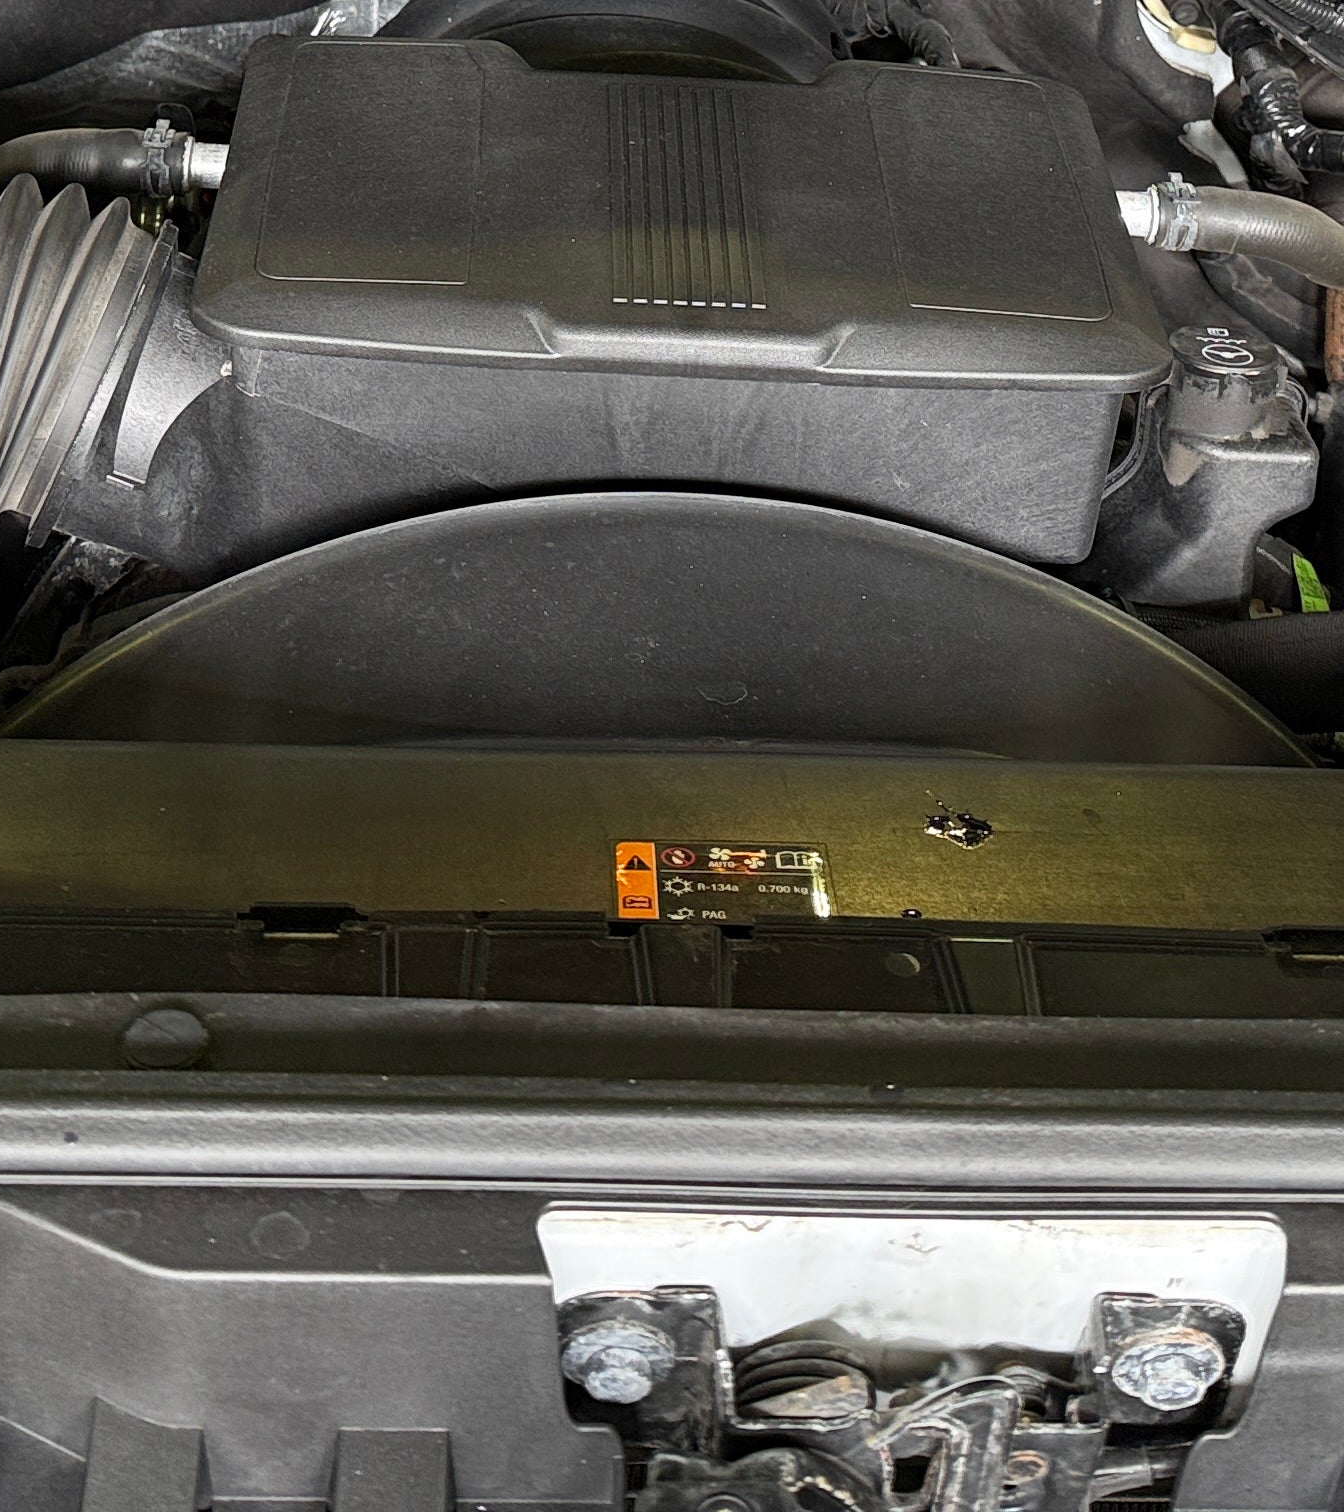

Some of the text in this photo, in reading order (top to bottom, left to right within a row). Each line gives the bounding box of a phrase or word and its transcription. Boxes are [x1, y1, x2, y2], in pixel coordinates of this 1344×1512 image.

[697, 882, 809, 895] R-134a 0.700 kg
[701, 909, 727, 920] PAG
